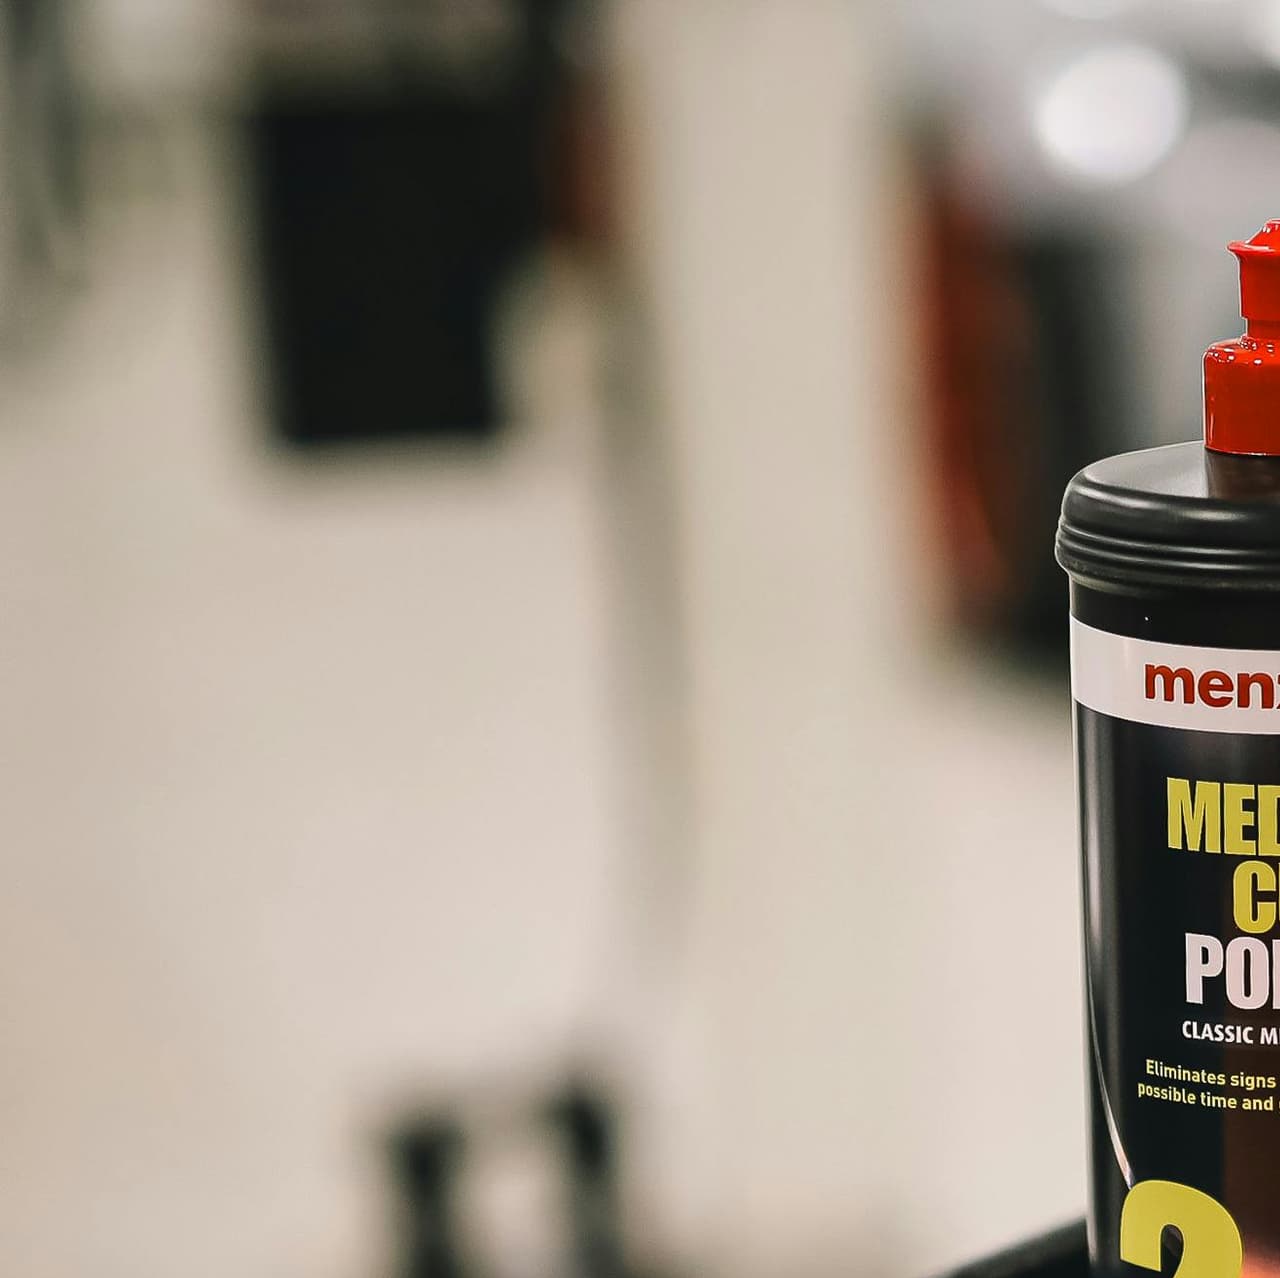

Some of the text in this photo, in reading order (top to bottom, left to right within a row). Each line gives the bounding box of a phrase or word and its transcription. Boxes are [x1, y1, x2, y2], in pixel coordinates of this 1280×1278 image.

[1182, 1020, 1254, 1044] CLASSIC
[1145, 1058, 1226, 1086] Eliminates
[1230, 1073, 1276, 1091] signs
[1137, 1083, 1196, 1105] possible
[1200, 1091, 1237, 1109] time
[1241, 1097, 1274, 1112] and
